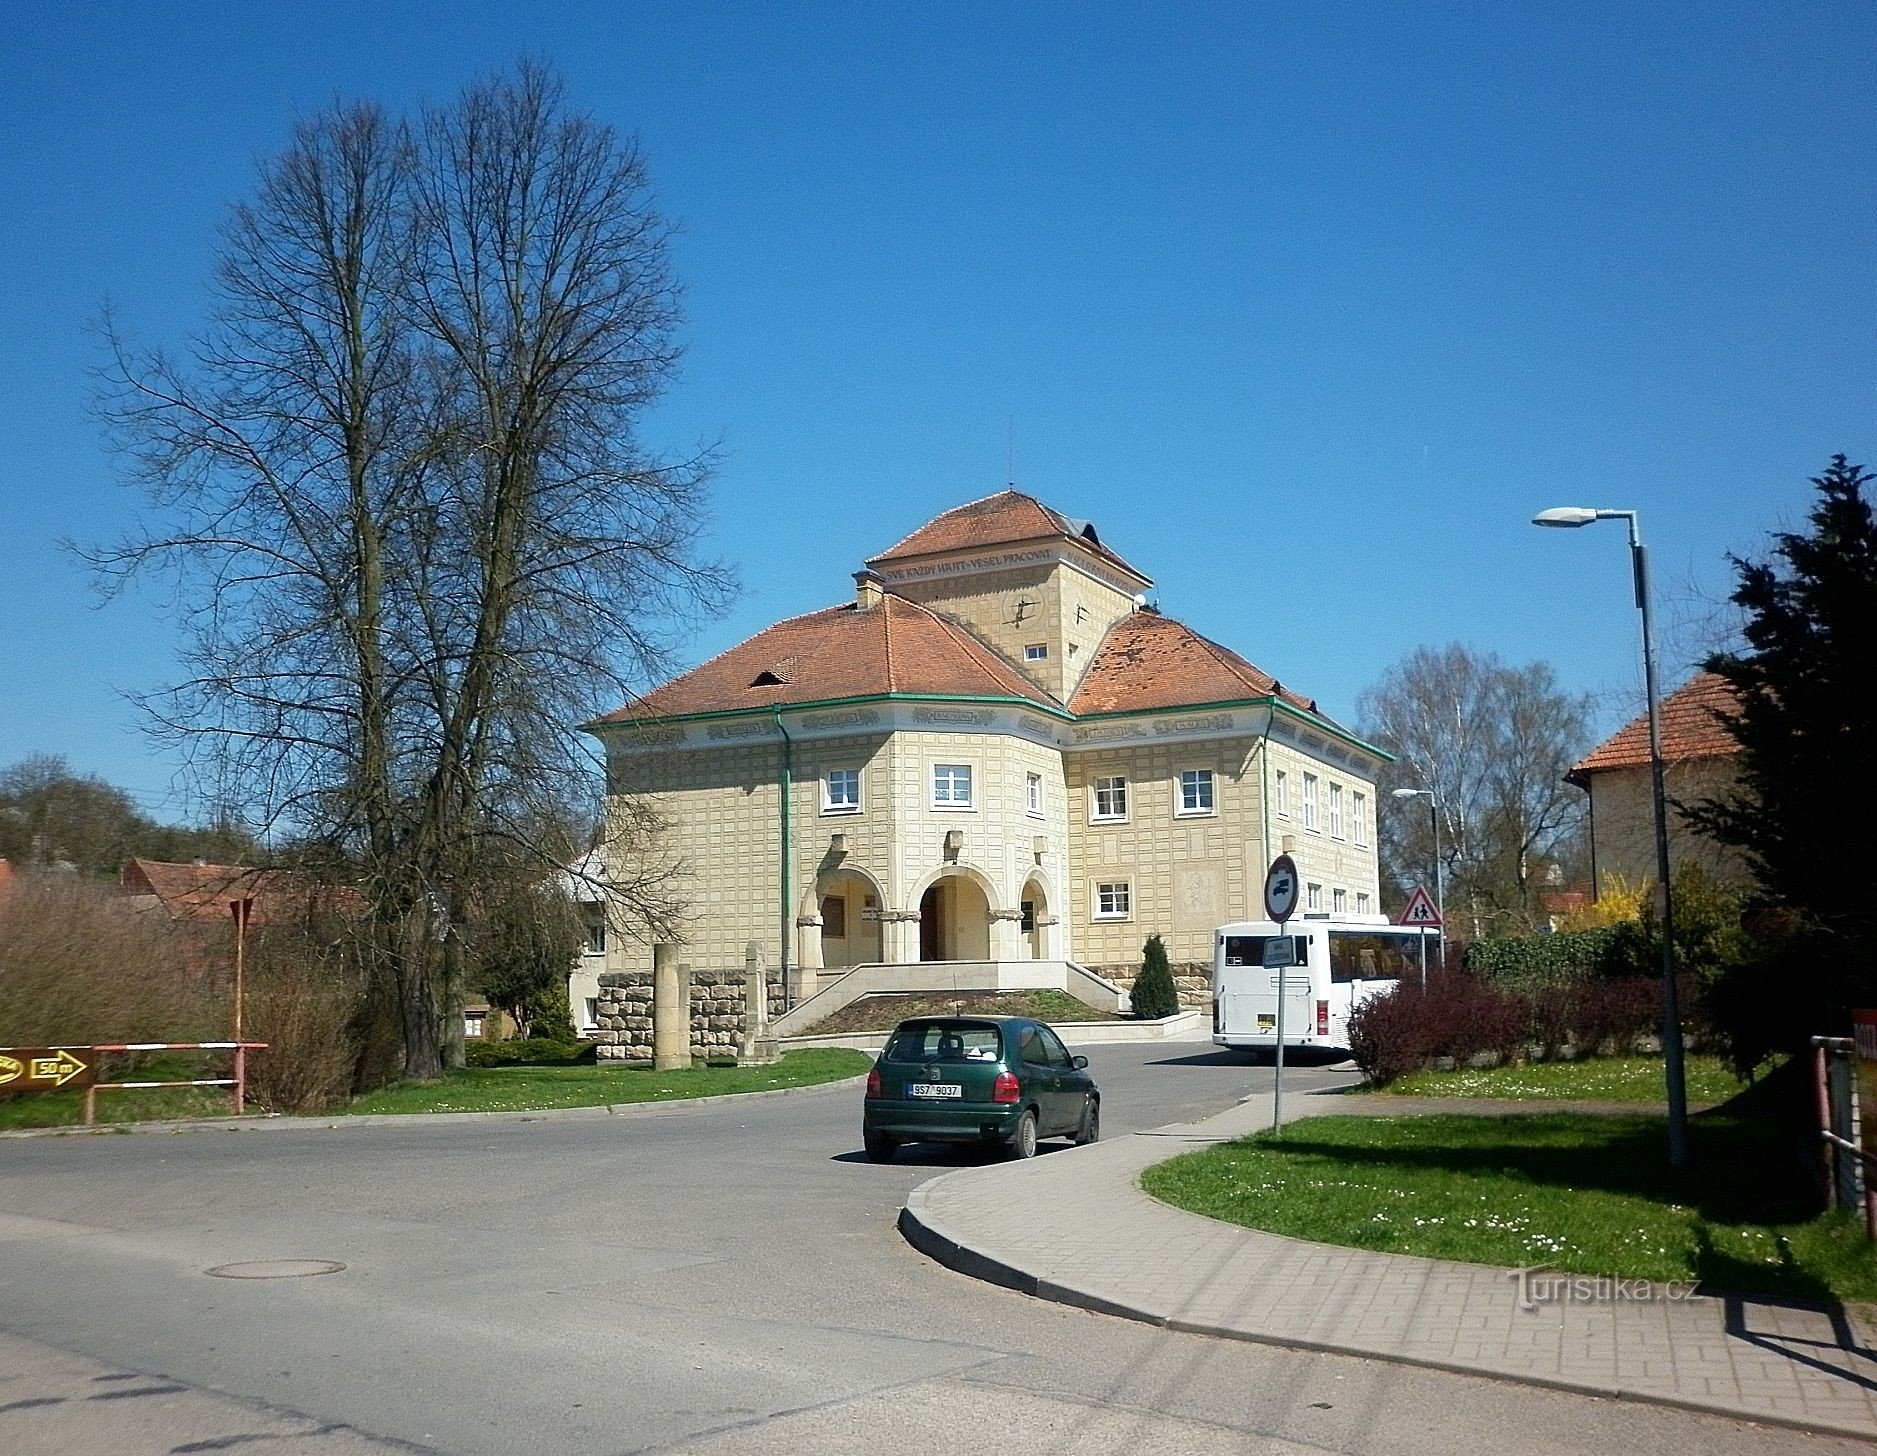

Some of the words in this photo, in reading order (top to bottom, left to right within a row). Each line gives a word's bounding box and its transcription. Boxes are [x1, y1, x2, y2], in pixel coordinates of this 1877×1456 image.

[40, 1062, 57, 1075] 50
[59, 1063, 73, 1074] m
[914, 1085, 930, 1095] 9S7
[936, 1086, 958, 1096] 9037
